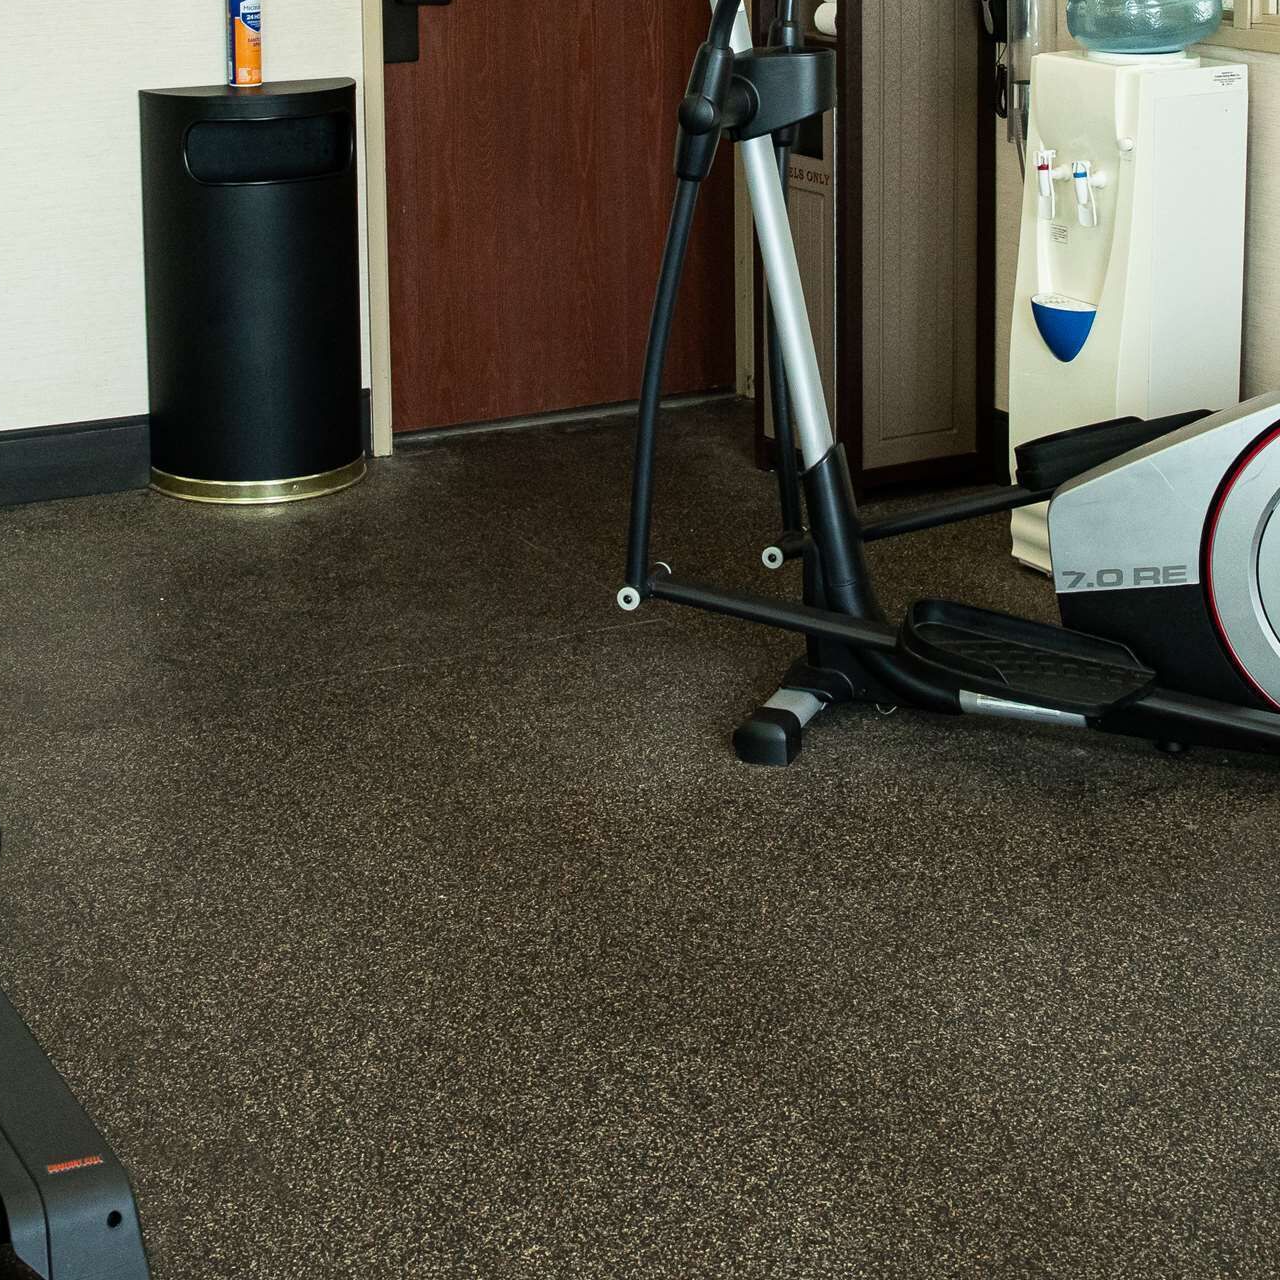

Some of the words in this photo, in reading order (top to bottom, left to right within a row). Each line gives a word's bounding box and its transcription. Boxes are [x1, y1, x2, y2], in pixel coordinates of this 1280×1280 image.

[806, 170, 830, 186] ONLY
[1062, 568, 1124, 589] 7.0
[1133, 565, 1188, 585] RE
